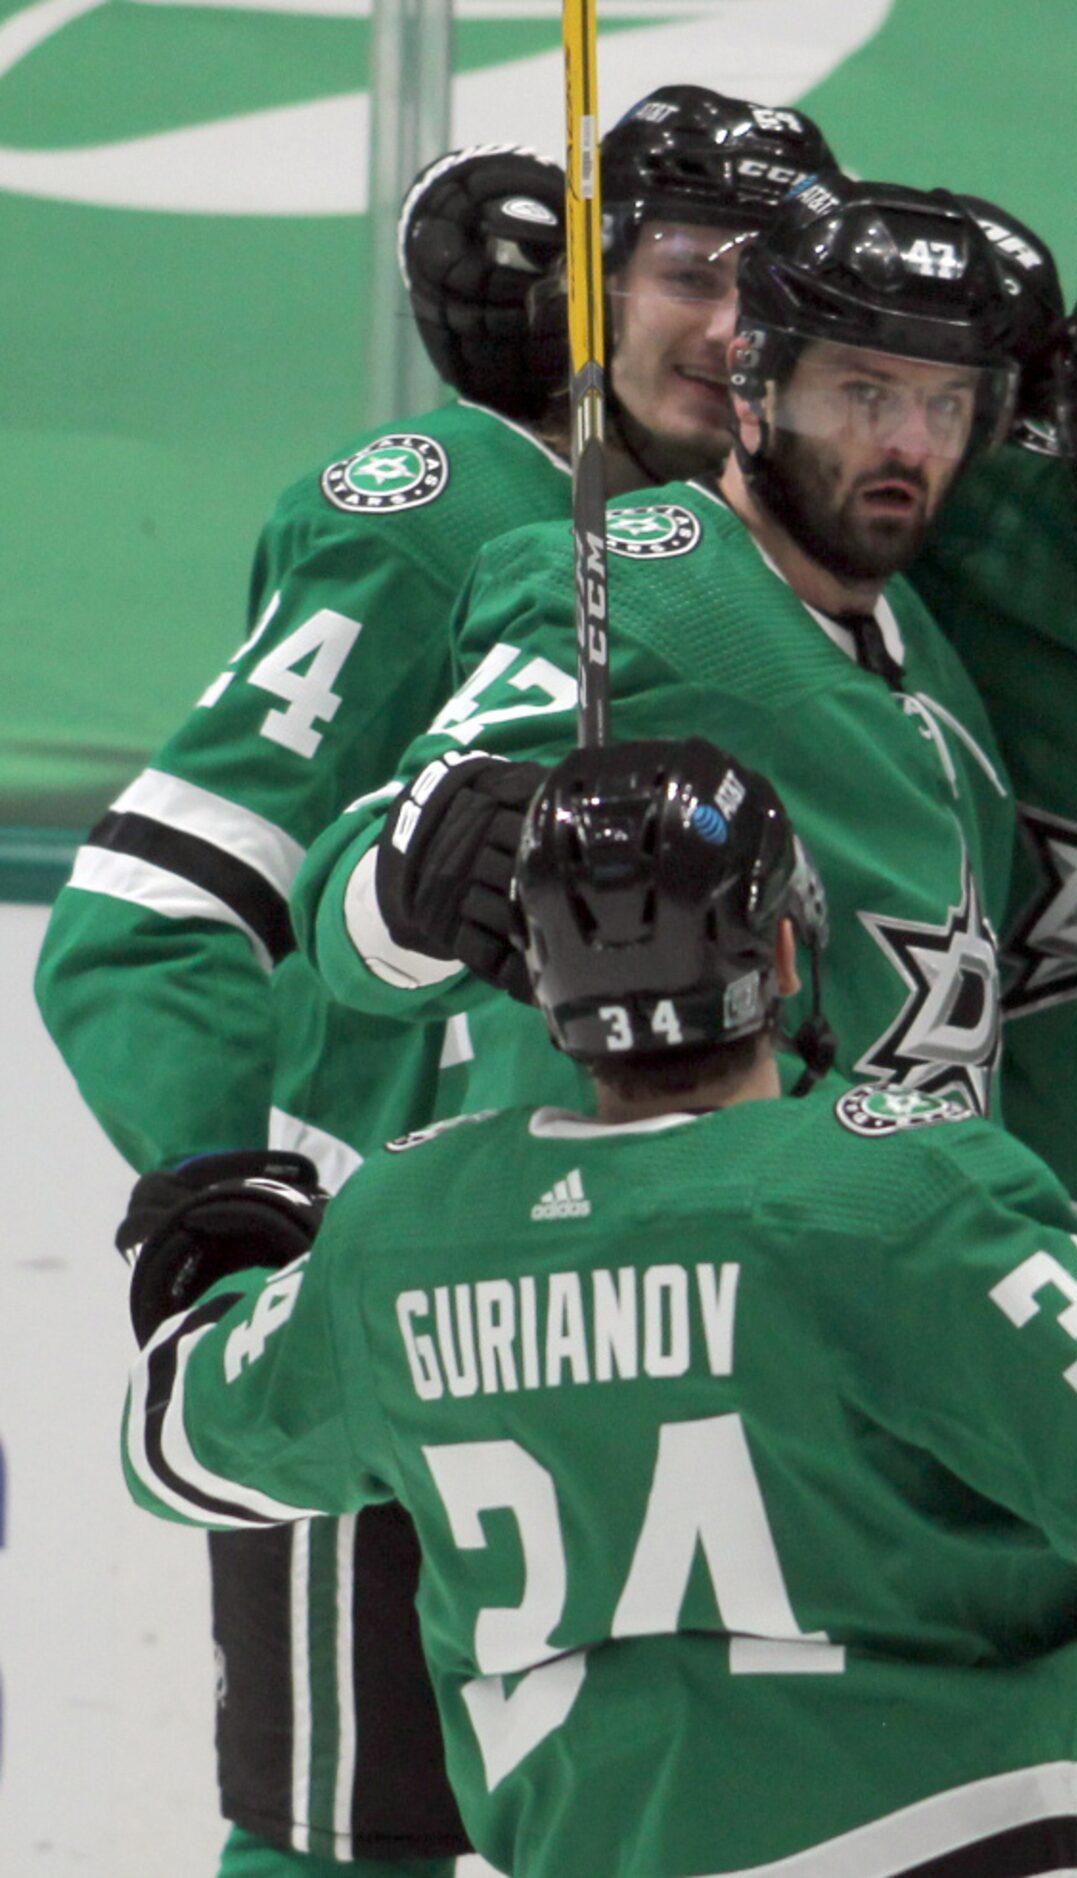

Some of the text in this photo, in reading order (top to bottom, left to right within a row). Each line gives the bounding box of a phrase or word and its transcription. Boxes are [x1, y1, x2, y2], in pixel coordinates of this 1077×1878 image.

[585, 531, 608, 667] CCM
[598, 1000, 684, 1051] 34
[531, 1200, 592, 1221] adidas
[396, 1262, 741, 1401] GURIANOV
